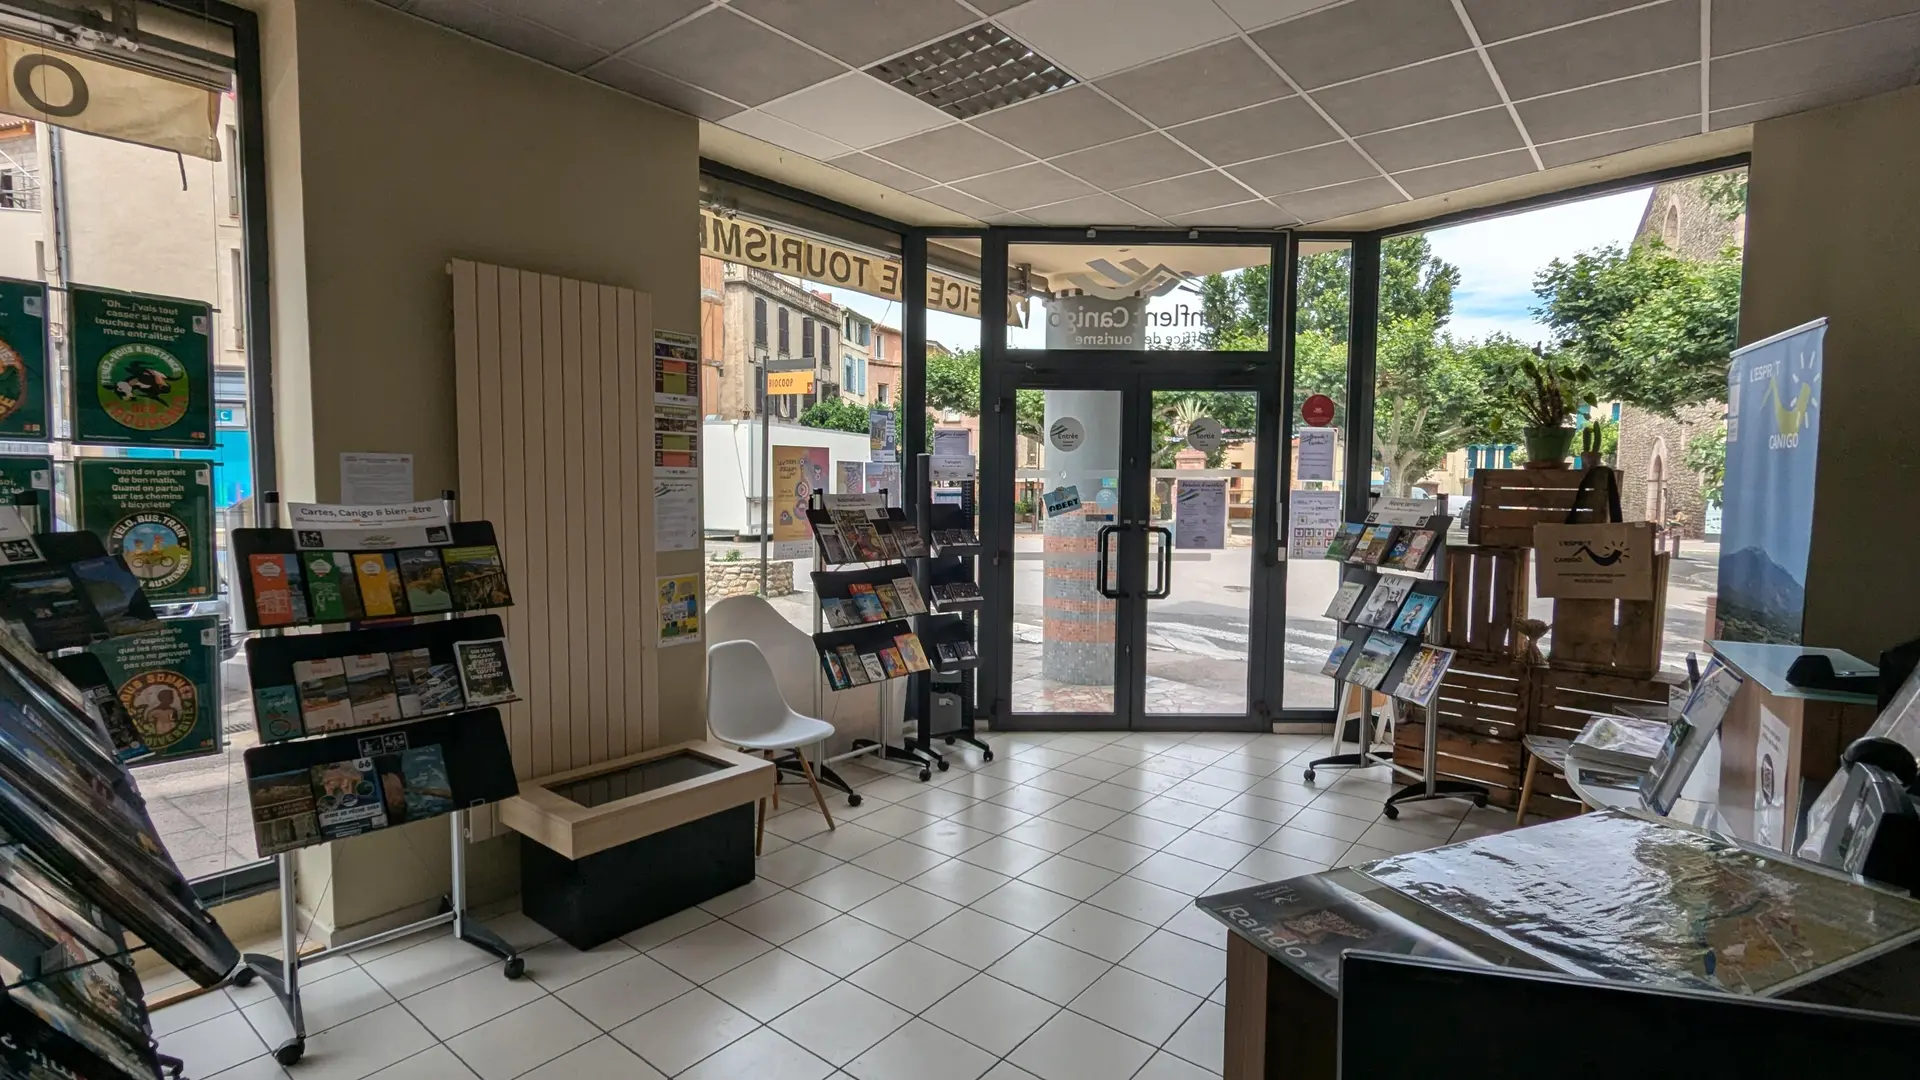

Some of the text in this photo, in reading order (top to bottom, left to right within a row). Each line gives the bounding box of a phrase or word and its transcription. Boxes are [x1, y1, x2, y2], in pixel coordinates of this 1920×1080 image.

[159, 306, 178, 315] tout
[106, 310, 140, 319] casser
[152, 316, 175, 324] vous
[95, 317, 135, 328] touchez
[151, 323, 172, 332] fruit
[173, 326, 186, 334] de
[103, 328, 125, 336] mes
[144, 346, 181, 373] DISTANCE
[157, 468, 186, 477] partait
[155, 484, 184, 493] partait
[301, 507, 337, 518] Cartes,
[384, 505, 432, 516] bien-être
[162, 516, 187, 538] TRAIN
[148, 554, 189, 587] AUTREMENT
[119, 647, 136, 655] que
[151, 643, 177, 651] moins
[123, 662, 139, 670] pas
[358, 760, 371, 768] 66
[1220, 905, 1307, 958] Rando
